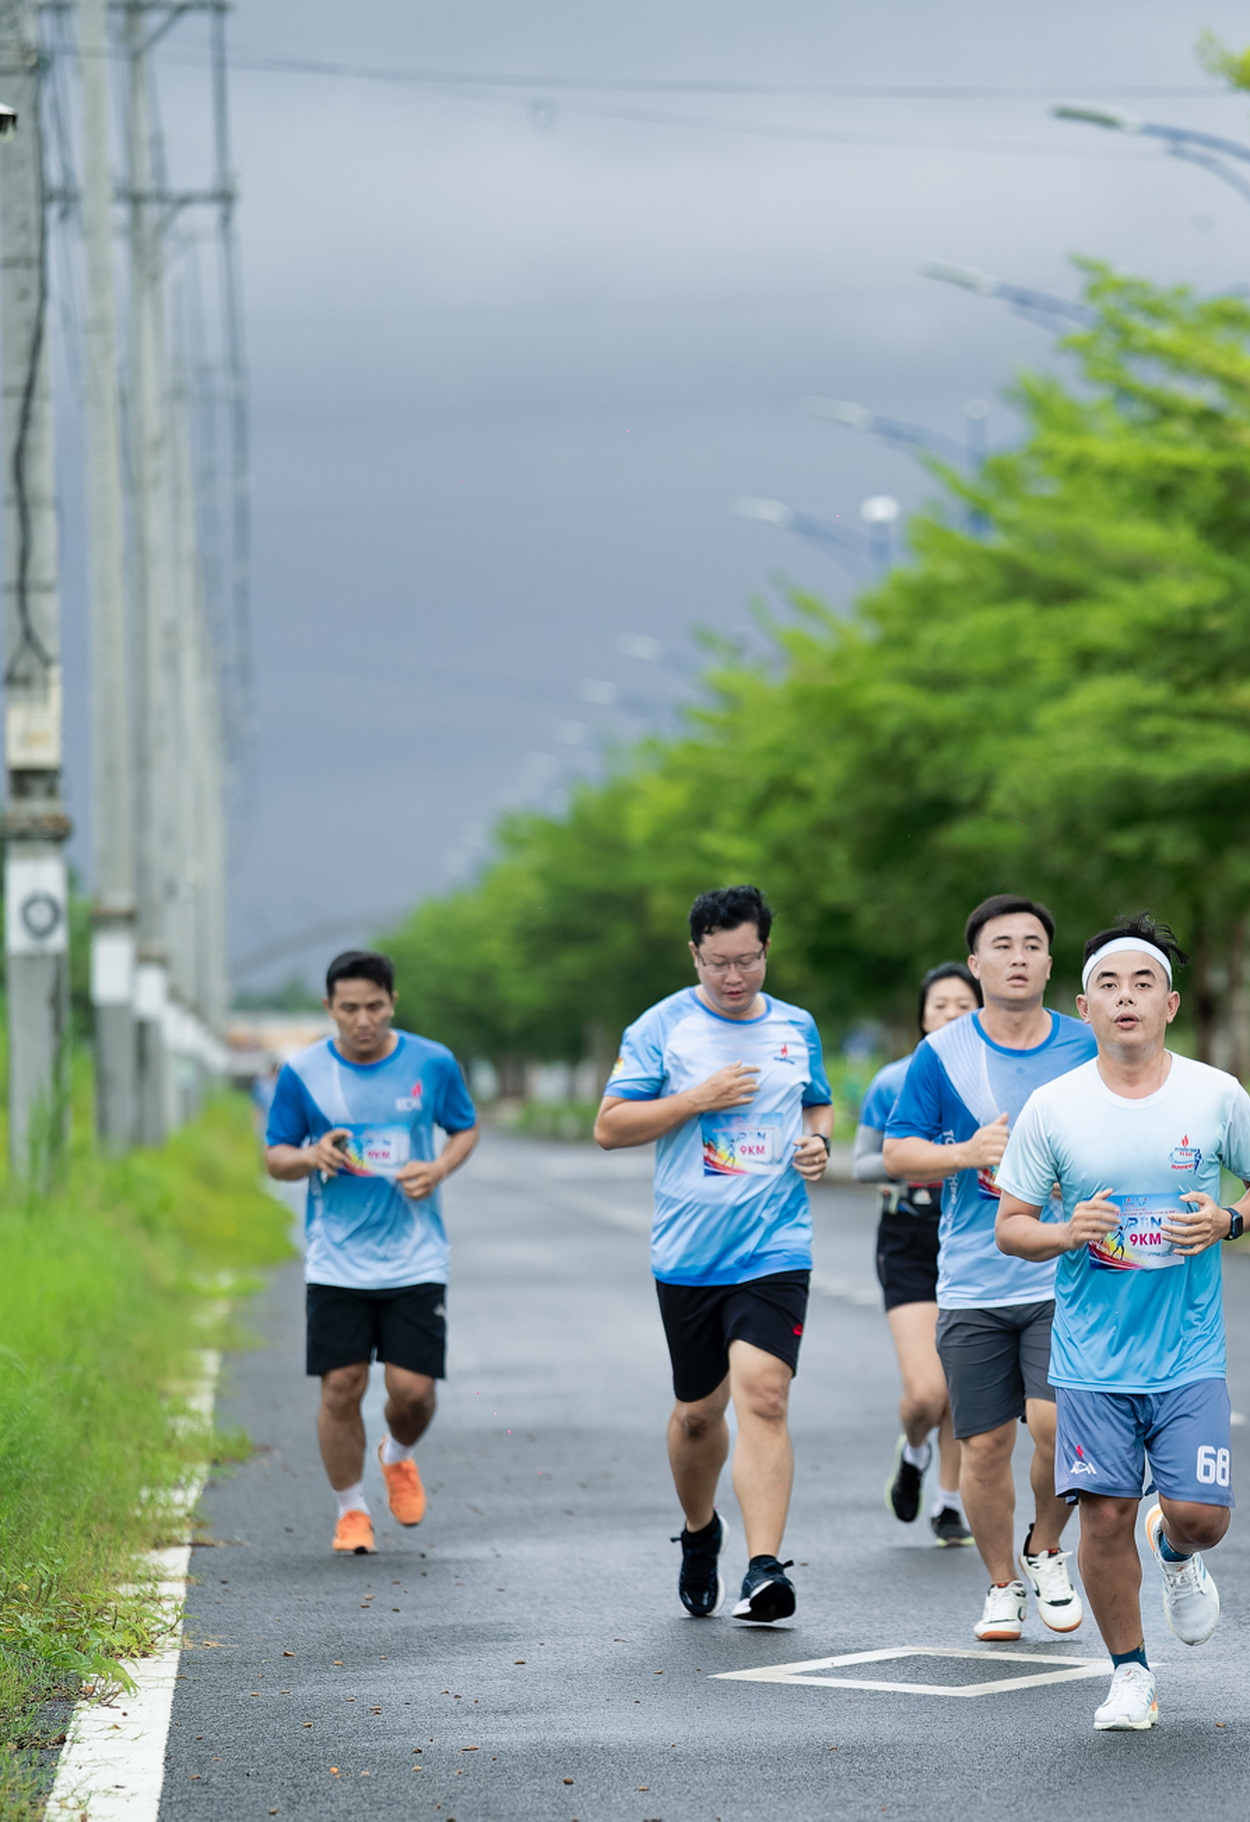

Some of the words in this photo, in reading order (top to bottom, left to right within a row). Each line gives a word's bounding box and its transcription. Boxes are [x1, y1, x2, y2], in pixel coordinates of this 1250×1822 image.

[740, 1145, 765, 1155] 9KM
[1129, 1233, 1162, 1246] 9KM
[1196, 1445, 1230, 1487] 68
